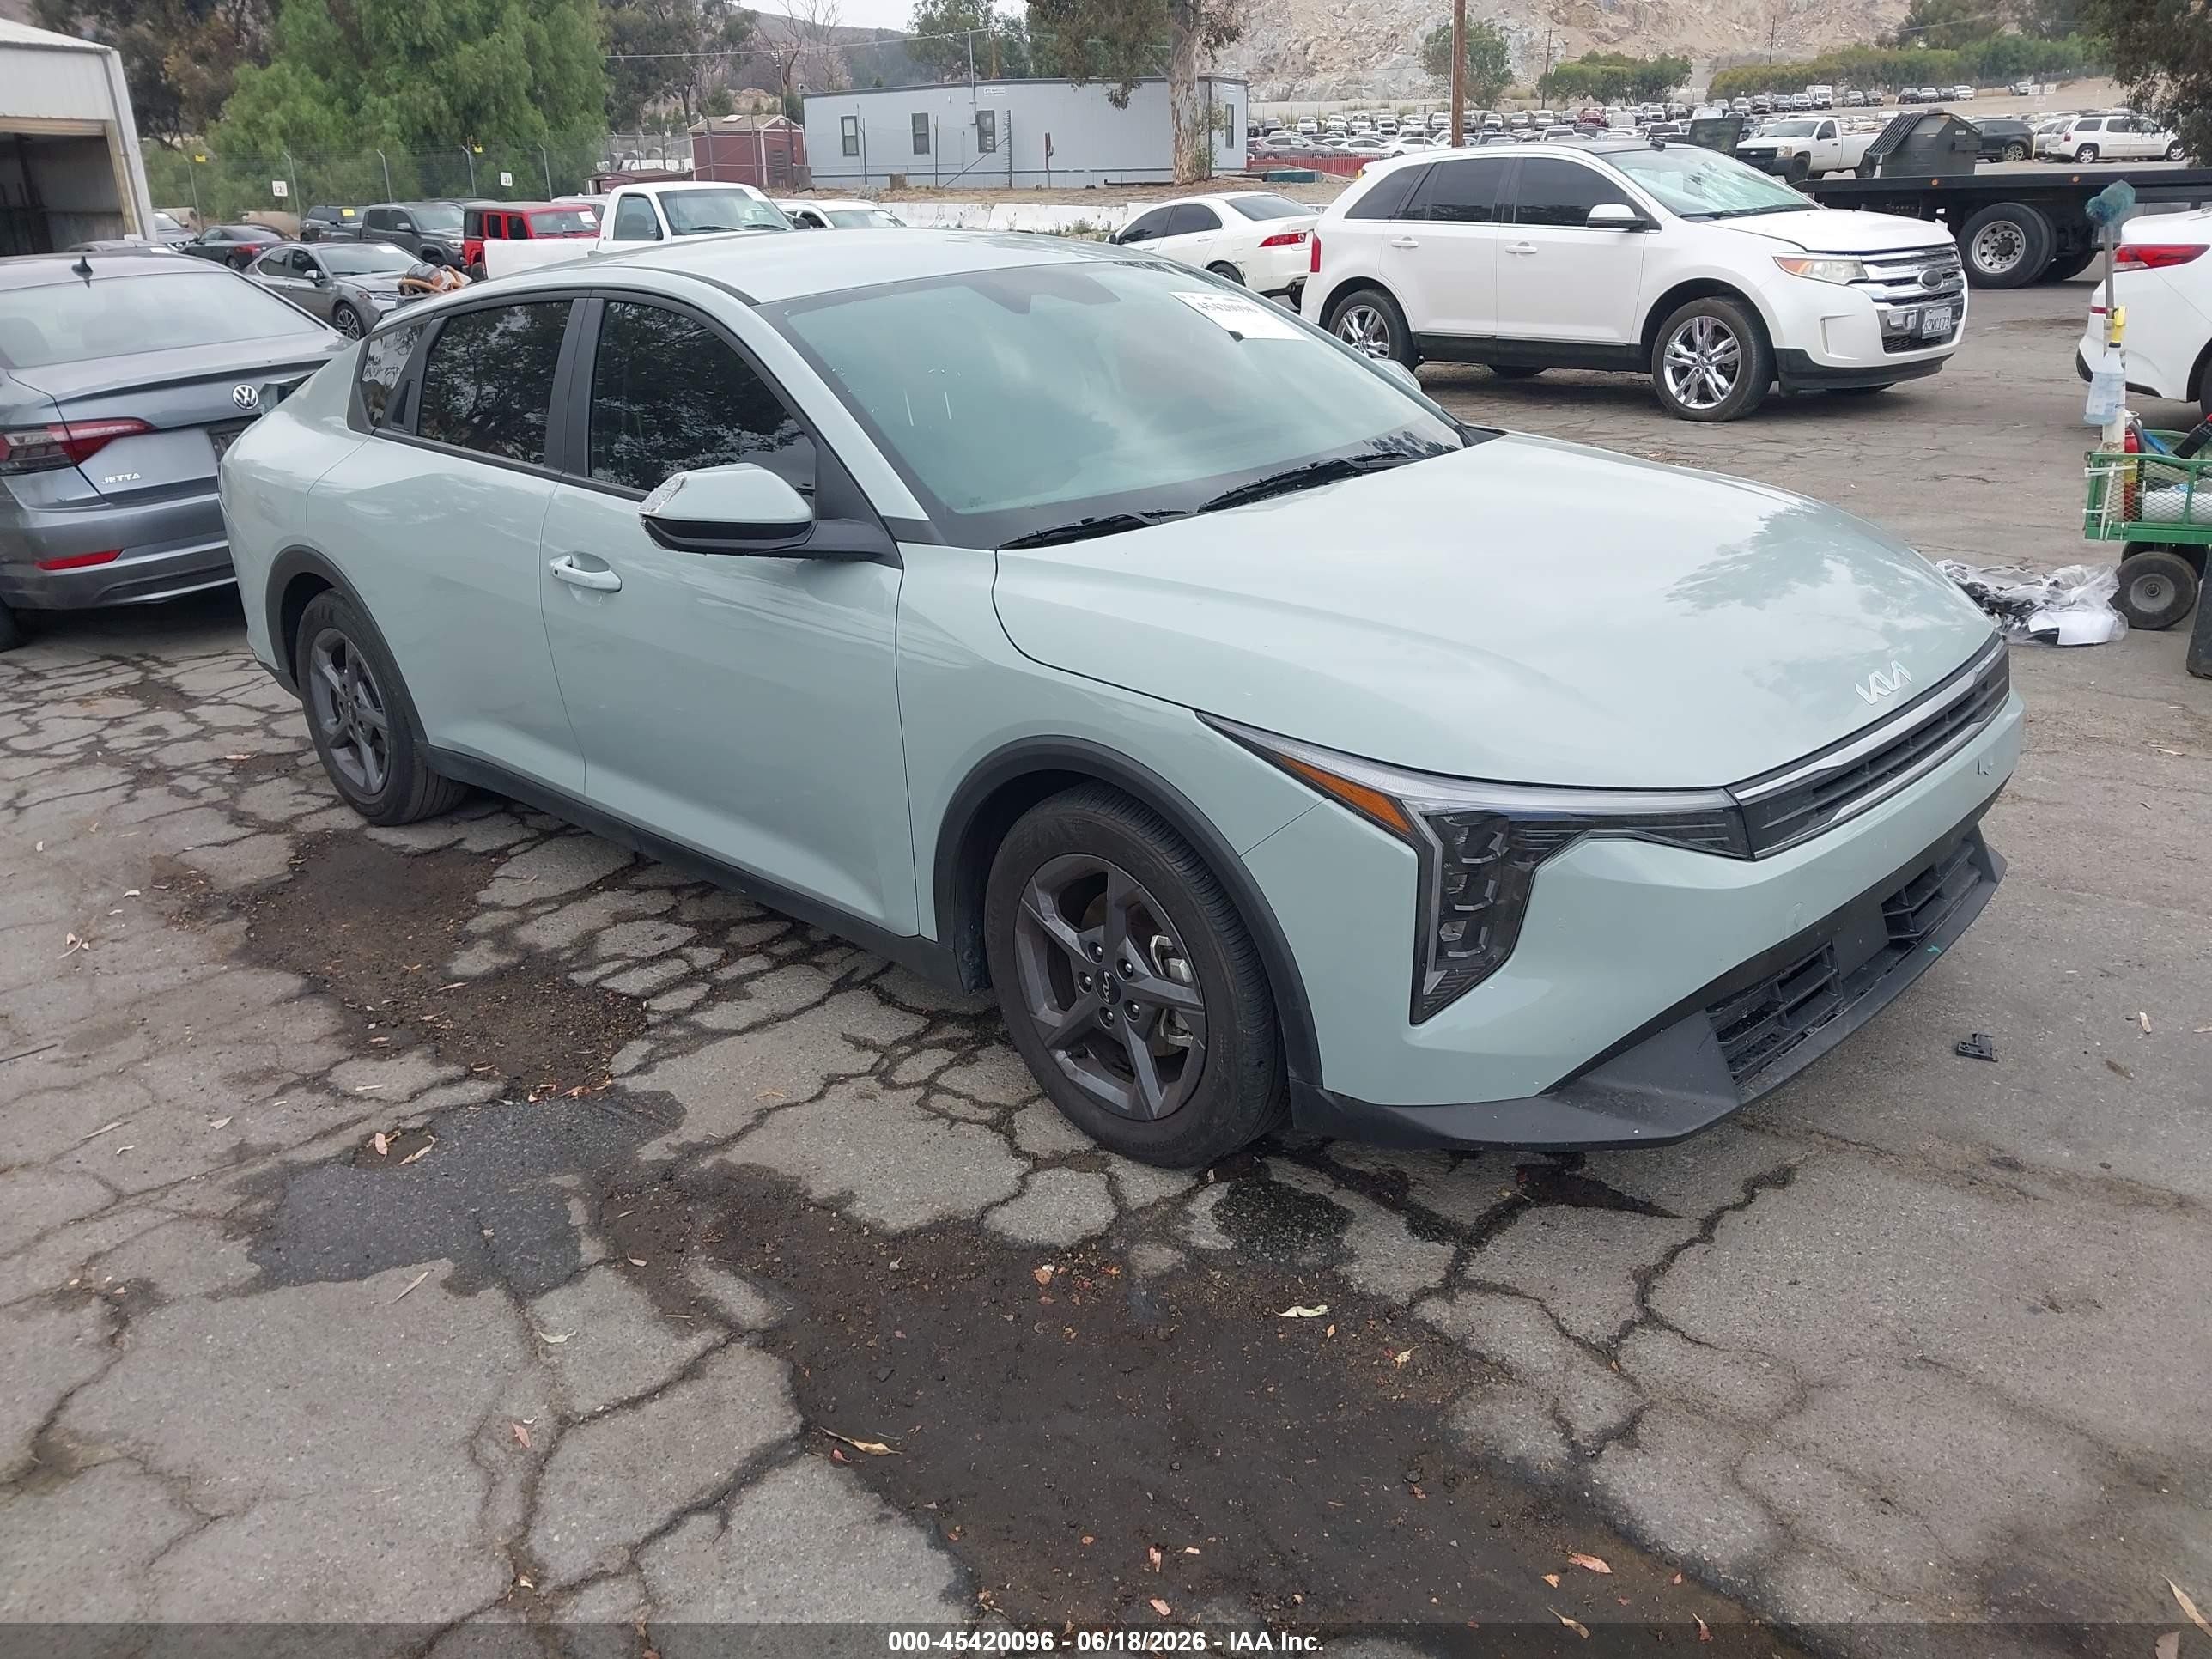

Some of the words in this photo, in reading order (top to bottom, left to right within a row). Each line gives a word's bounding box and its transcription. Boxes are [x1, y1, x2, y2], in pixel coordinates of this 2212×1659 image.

[233, 385, 258, 409] VW
[101, 472, 141, 484] JETTA
[1855, 659, 1912, 705] KIA
